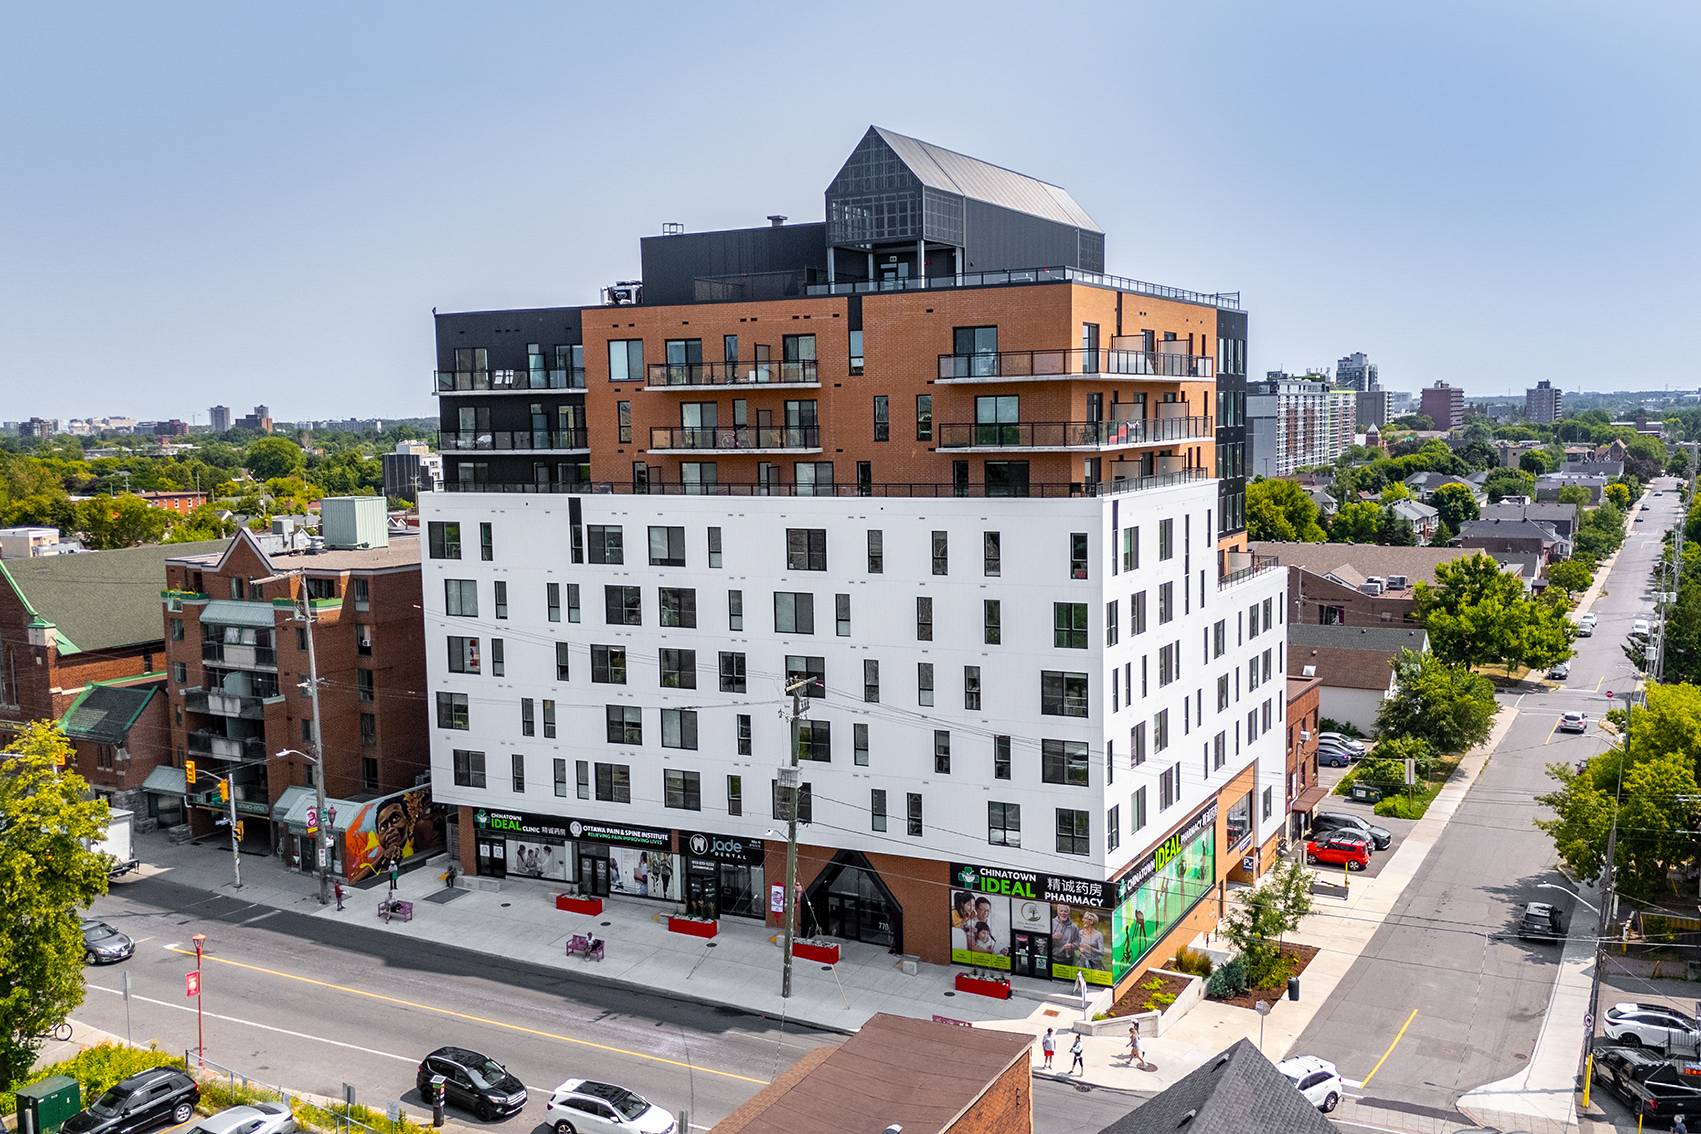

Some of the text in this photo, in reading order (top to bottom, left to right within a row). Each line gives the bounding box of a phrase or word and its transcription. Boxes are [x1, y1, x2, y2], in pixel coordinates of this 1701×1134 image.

[491, 813, 522, 821] CHINATOWN
[491, 818, 522, 831] IDEAL
[582, 825, 606, 833] OTTAWA
[625, 829, 640, 837] SPINE
[641, 831, 668, 840] INSTITUTE
[710, 837, 742, 853] jade
[714, 852, 747, 860] DENTAL
[1127, 859, 1156, 891] CHINATOWN
[1155, 833, 1182, 873] IDEAL
[980, 868, 1037, 882] CHINATOWN
[981, 877, 1036, 898] IDEAL
[1047, 877, 1103, 897] 精诚药房
[1044, 891, 1104, 907] PHARMACY
